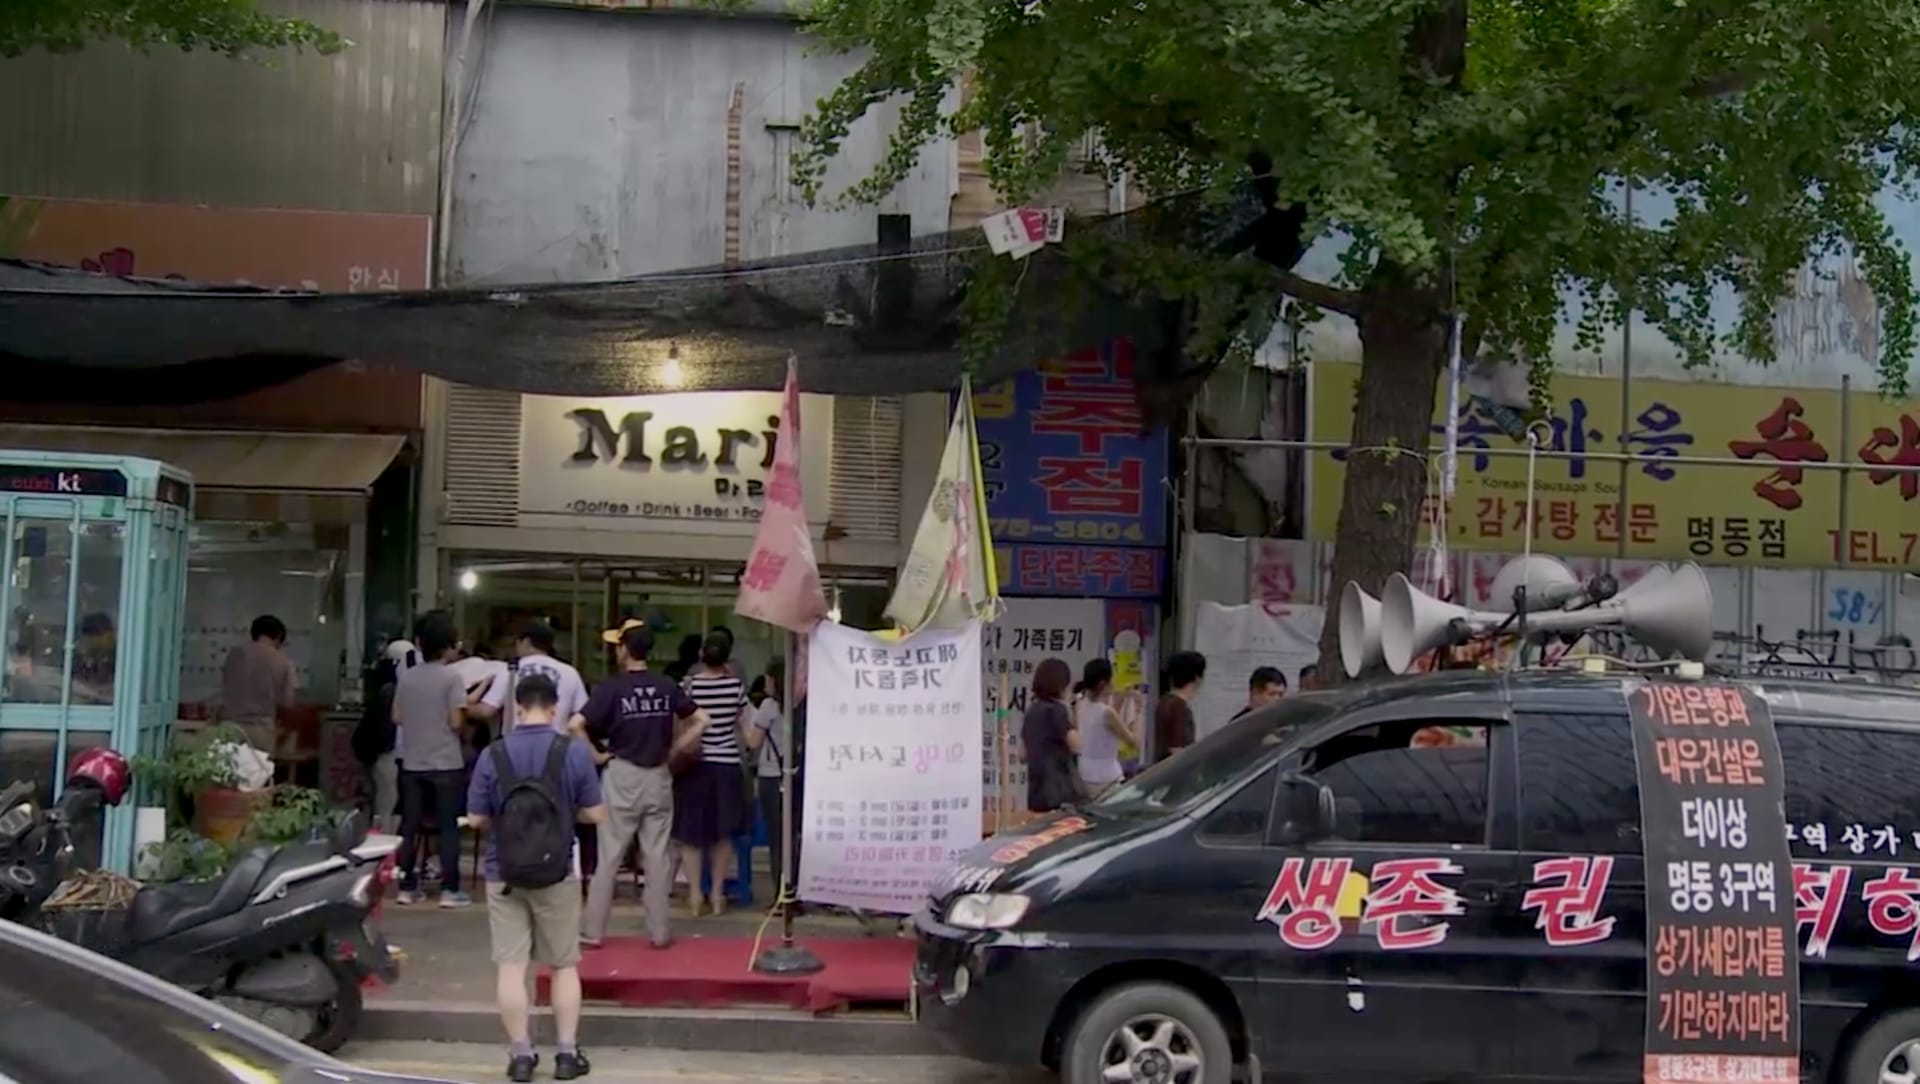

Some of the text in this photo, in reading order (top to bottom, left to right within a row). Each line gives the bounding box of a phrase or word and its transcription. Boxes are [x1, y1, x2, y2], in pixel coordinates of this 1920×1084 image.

[564, 408, 780, 467] Mari
[1481, 477, 1526, 489] Korean
[1534, 479, 1587, 493] Sausage
[1595, 482, 1621, 494] Sou
[574, 500, 629, 514] Coffee
[643, 502, 681, 516] Drink
[694, 505, 729, 517] Beer
[1476, 497, 1580, 542] 감자탕
[1593, 502, 1660, 544] 전문
[1687, 516, 1786, 559] 명동점
[1020, 548, 1156, 591] 단란주점
[1013, 628, 1083, 651] 가족돕기
[621, 695, 671, 714] Mari
[1640, 685, 1751, 727] 기업은행과
[1655, 738, 1766, 785] 대우건설은
[1681, 797, 1748, 849] 더이상
[1840, 823, 1901, 856] 상가
[1667, 860, 1777, 913] 명동 3구역
[1654, 924, 1785, 977] 상가세입자를
[1658, 988, 1790, 1043] 기만하지마라
